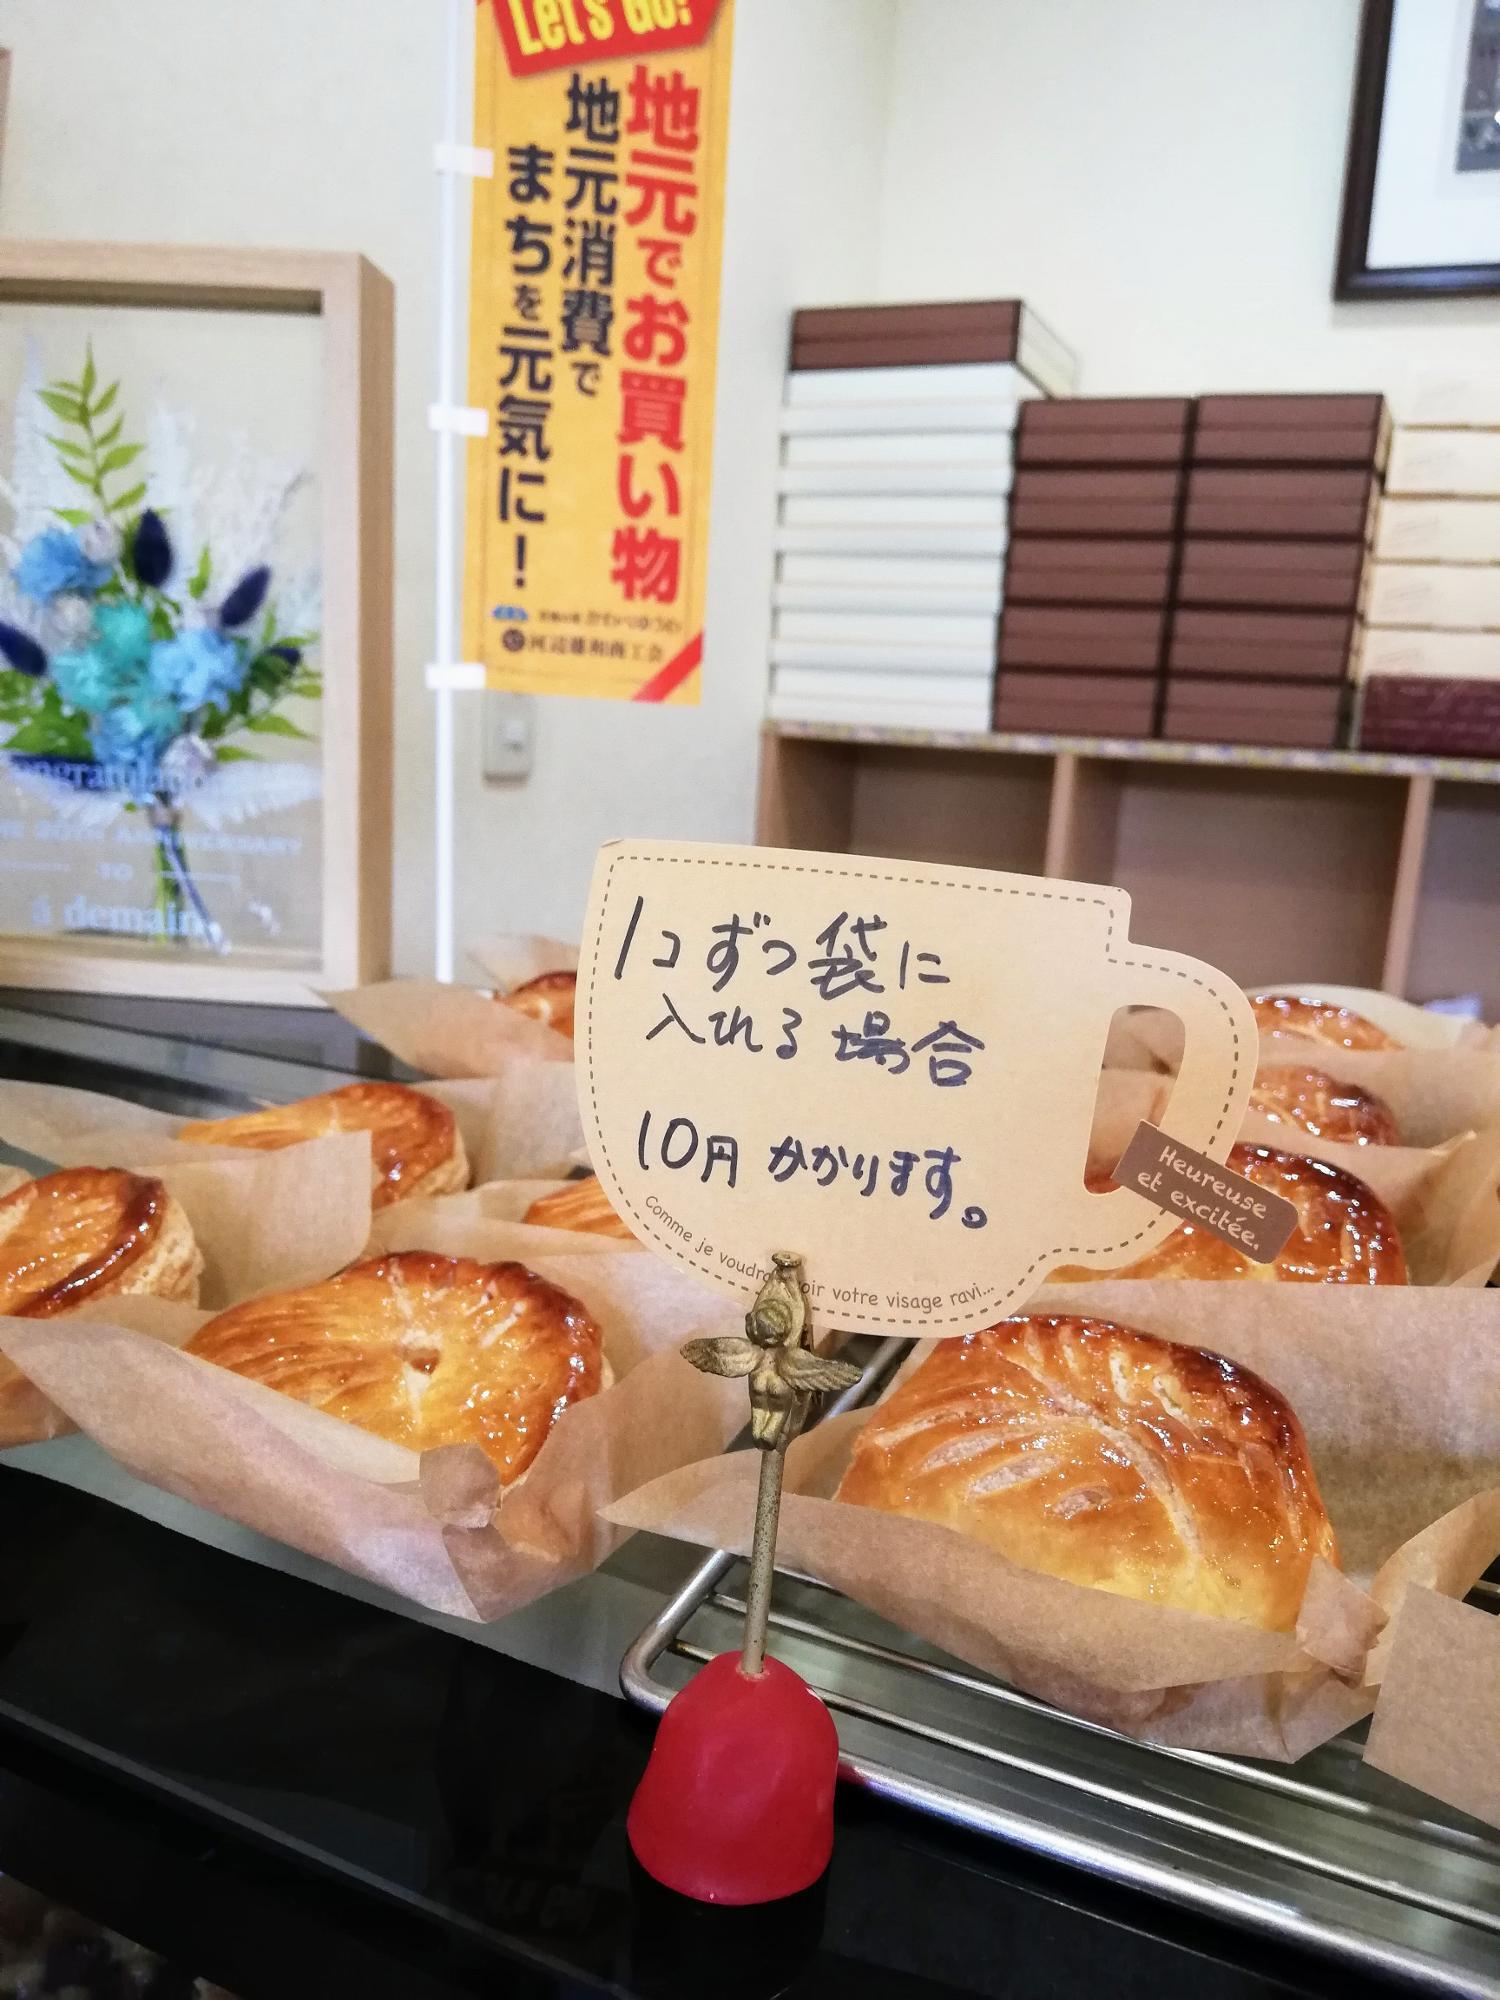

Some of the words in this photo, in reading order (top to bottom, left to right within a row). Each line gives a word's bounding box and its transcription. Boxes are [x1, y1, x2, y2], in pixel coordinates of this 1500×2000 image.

[560, 72, 620, 398] 地元消費で
[611, 64, 701, 605] 地元でお買い物
[1136, 1171, 1164, 1193] et
[1169, 1189, 1261, 1251] excitée.
[1158, 1145, 1268, 1220] Heureuse
[645, 1195, 694, 1243] Comme
[695, 1237, 714, 1256] je
[832, 1286, 879, 1307] votre
[886, 1291, 944, 1315] visage
